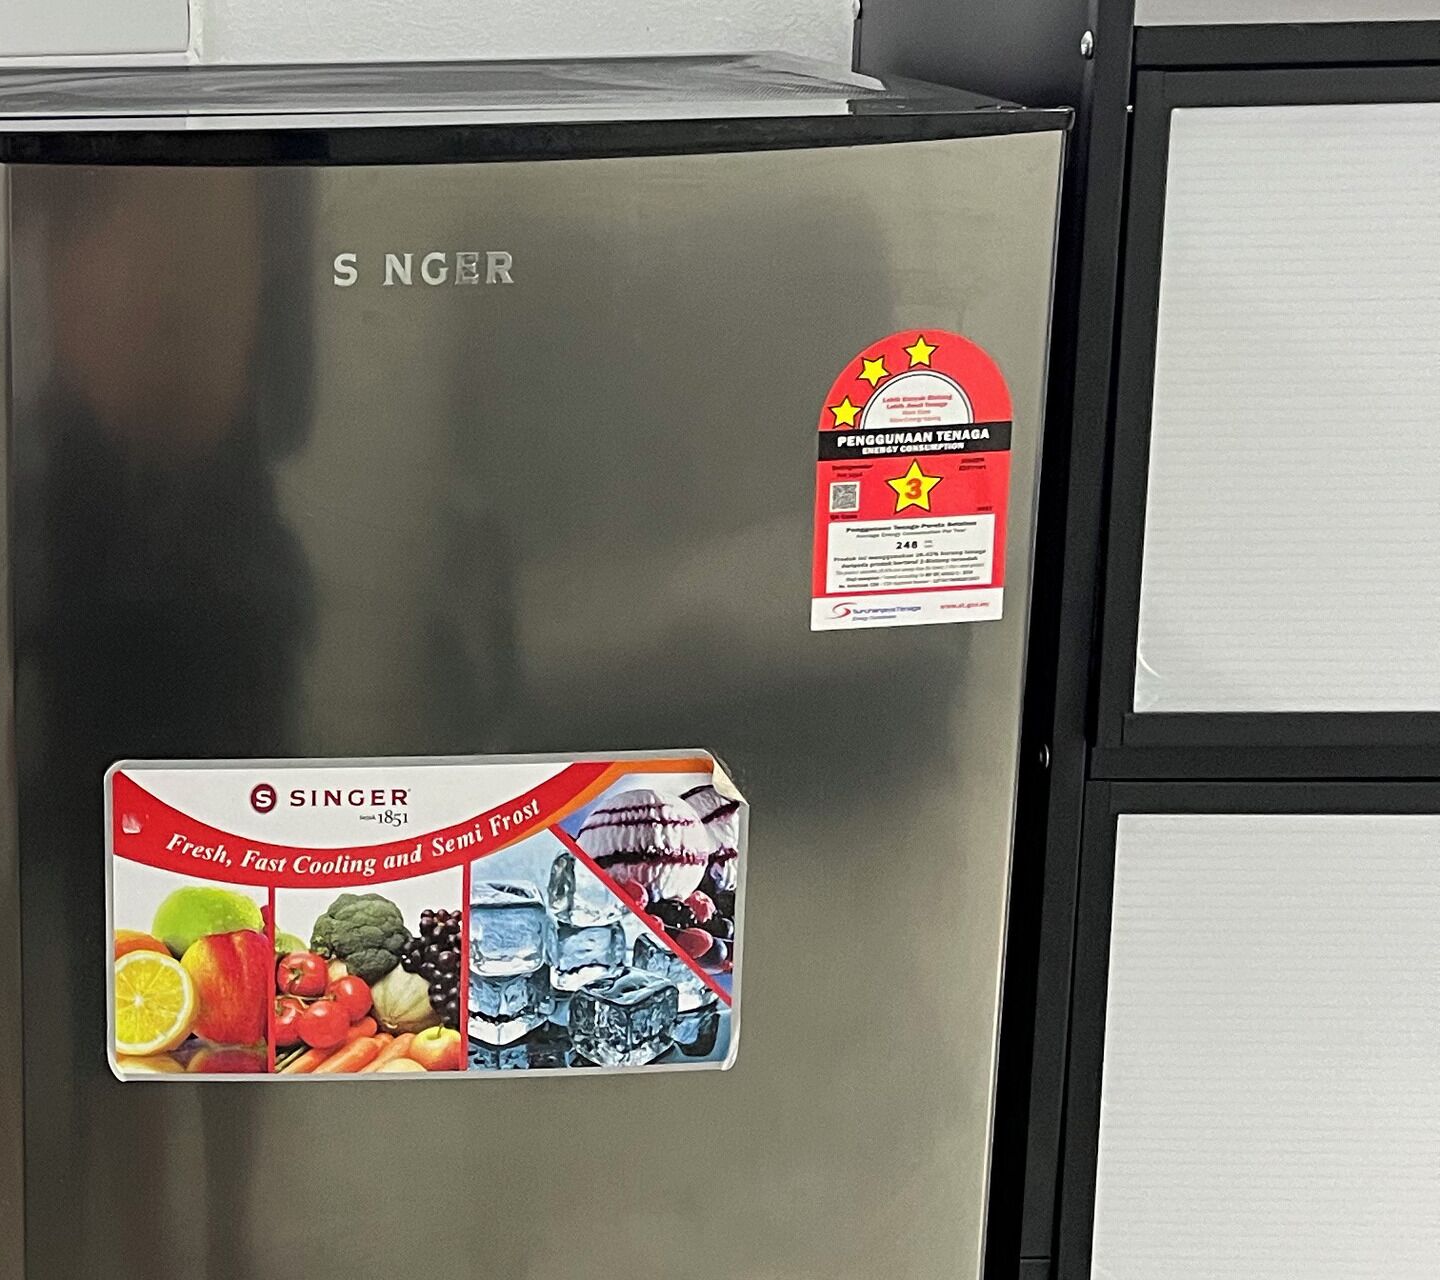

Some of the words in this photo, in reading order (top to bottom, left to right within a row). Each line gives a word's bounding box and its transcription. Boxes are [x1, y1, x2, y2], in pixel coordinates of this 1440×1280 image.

[837, 431, 933, 448] PENGGUNAAN
[936, 428, 990, 442] TENAGA
[862, 446, 898, 455] ENERGY
[900, 442, 965, 453] CONSUMPTION
[905, 477, 922, 500] 3
[290, 788, 408, 807] SINGER
[377, 809, 409, 828] 1851
[165, 832, 233, 868] Fresh,
[240, 849, 288, 873] Fast
[292, 854, 377, 877] Cooling
[383, 843, 423, 870] and
[431, 823, 484, 858] Semi
[488, 798, 541, 838] Frost
